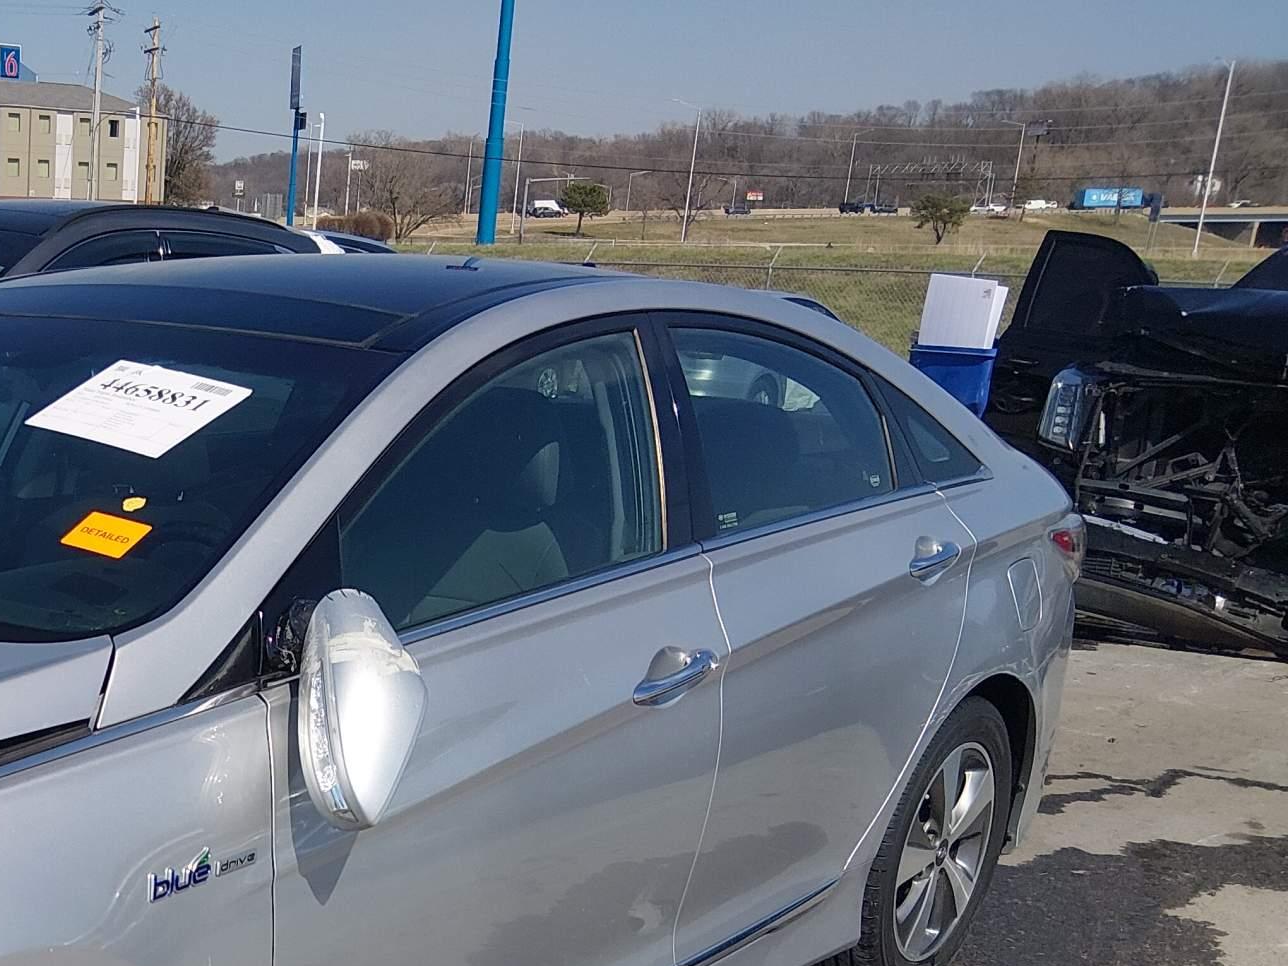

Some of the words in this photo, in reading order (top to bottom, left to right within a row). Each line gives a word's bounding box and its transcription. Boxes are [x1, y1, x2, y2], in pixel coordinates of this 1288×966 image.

[5, 51, 18, 77] 6
[99, 377, 211, 412] 44658831
[80, 526, 130, 544] DETAILED
[147, 859, 212, 903] blue
[220, 851, 256, 873] drive
